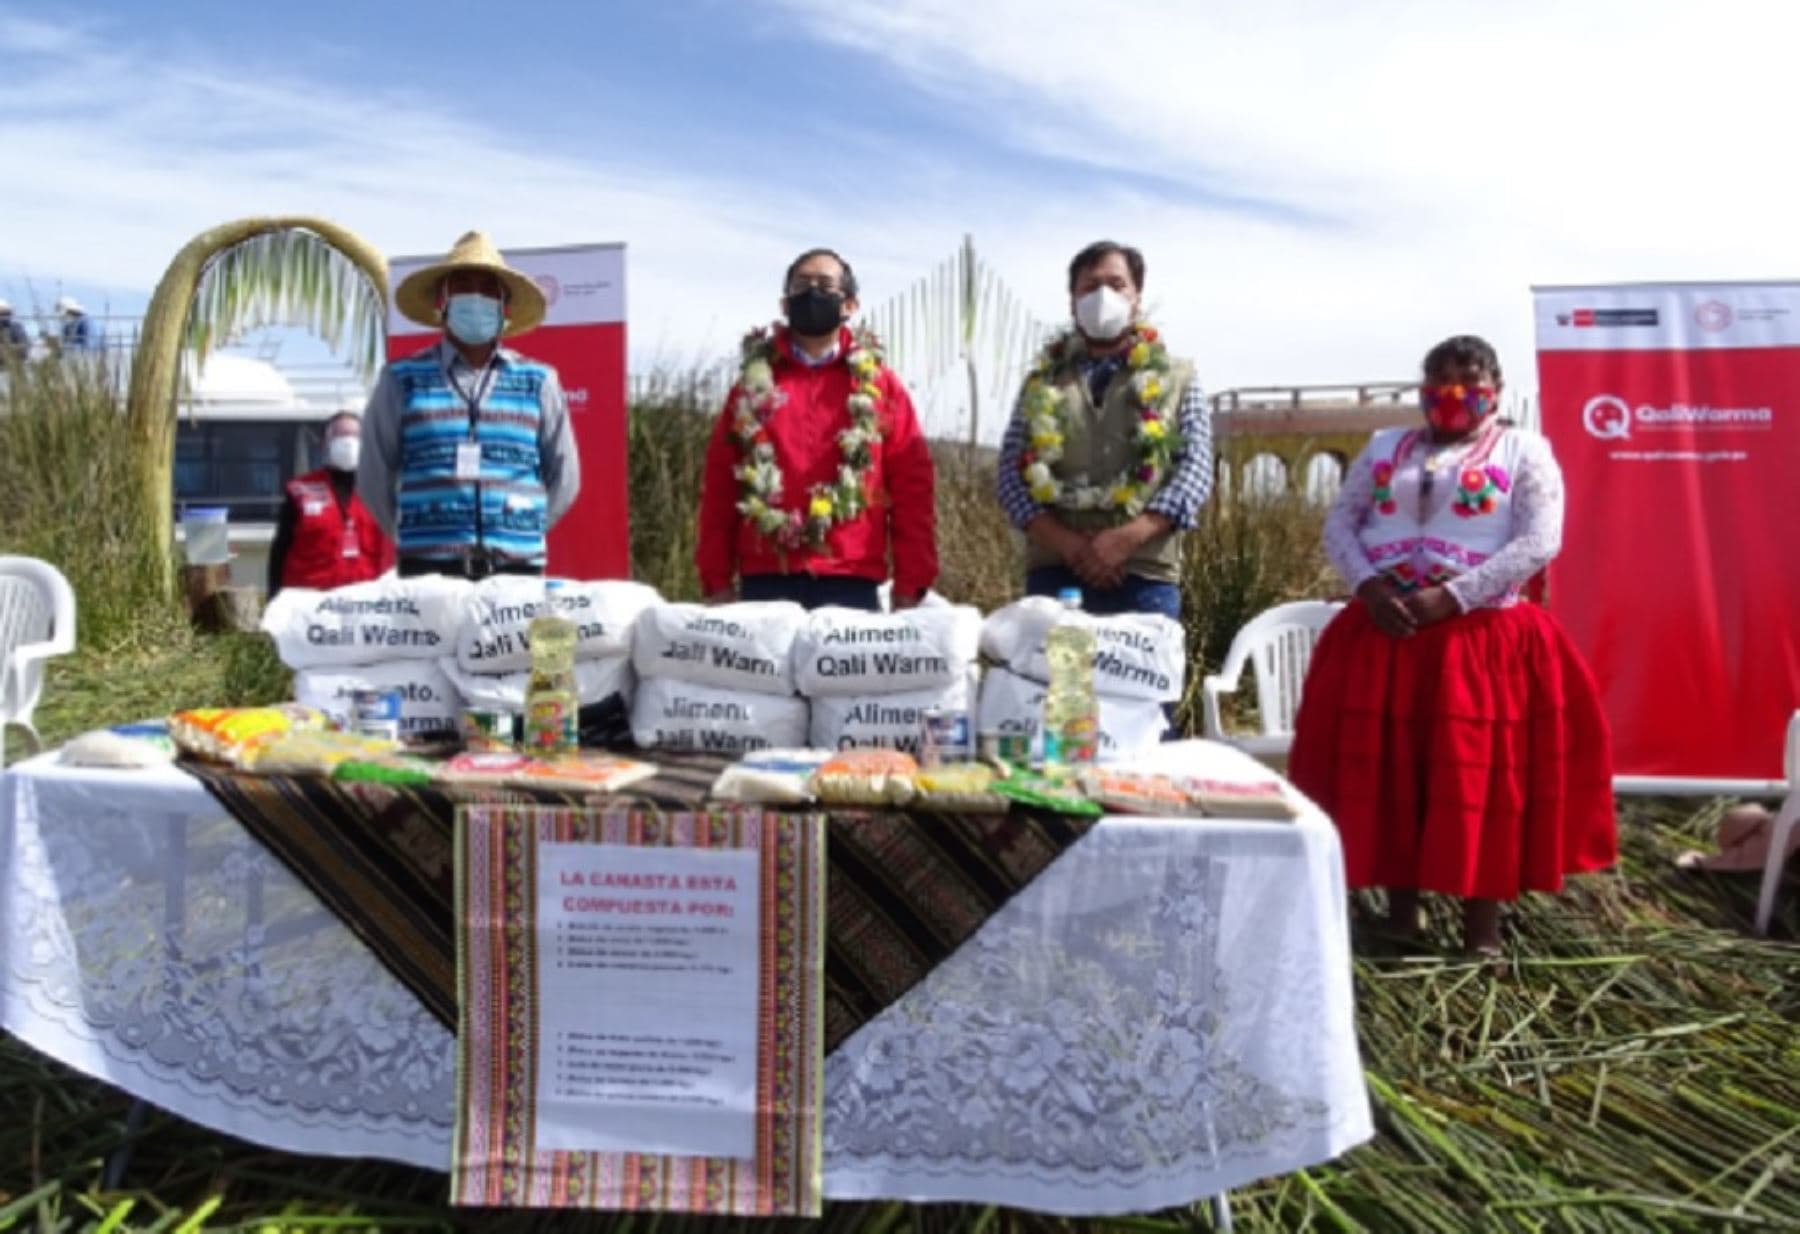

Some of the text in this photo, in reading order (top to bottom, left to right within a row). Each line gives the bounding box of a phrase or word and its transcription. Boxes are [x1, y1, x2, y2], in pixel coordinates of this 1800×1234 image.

[306, 624, 355, 647] Qali
[816, 652, 867, 677] Qali
[560, 870, 585, 886] LA
[590, 871, 681, 890] CANASTA
[563, 896, 683, 915] COMPUESTA
